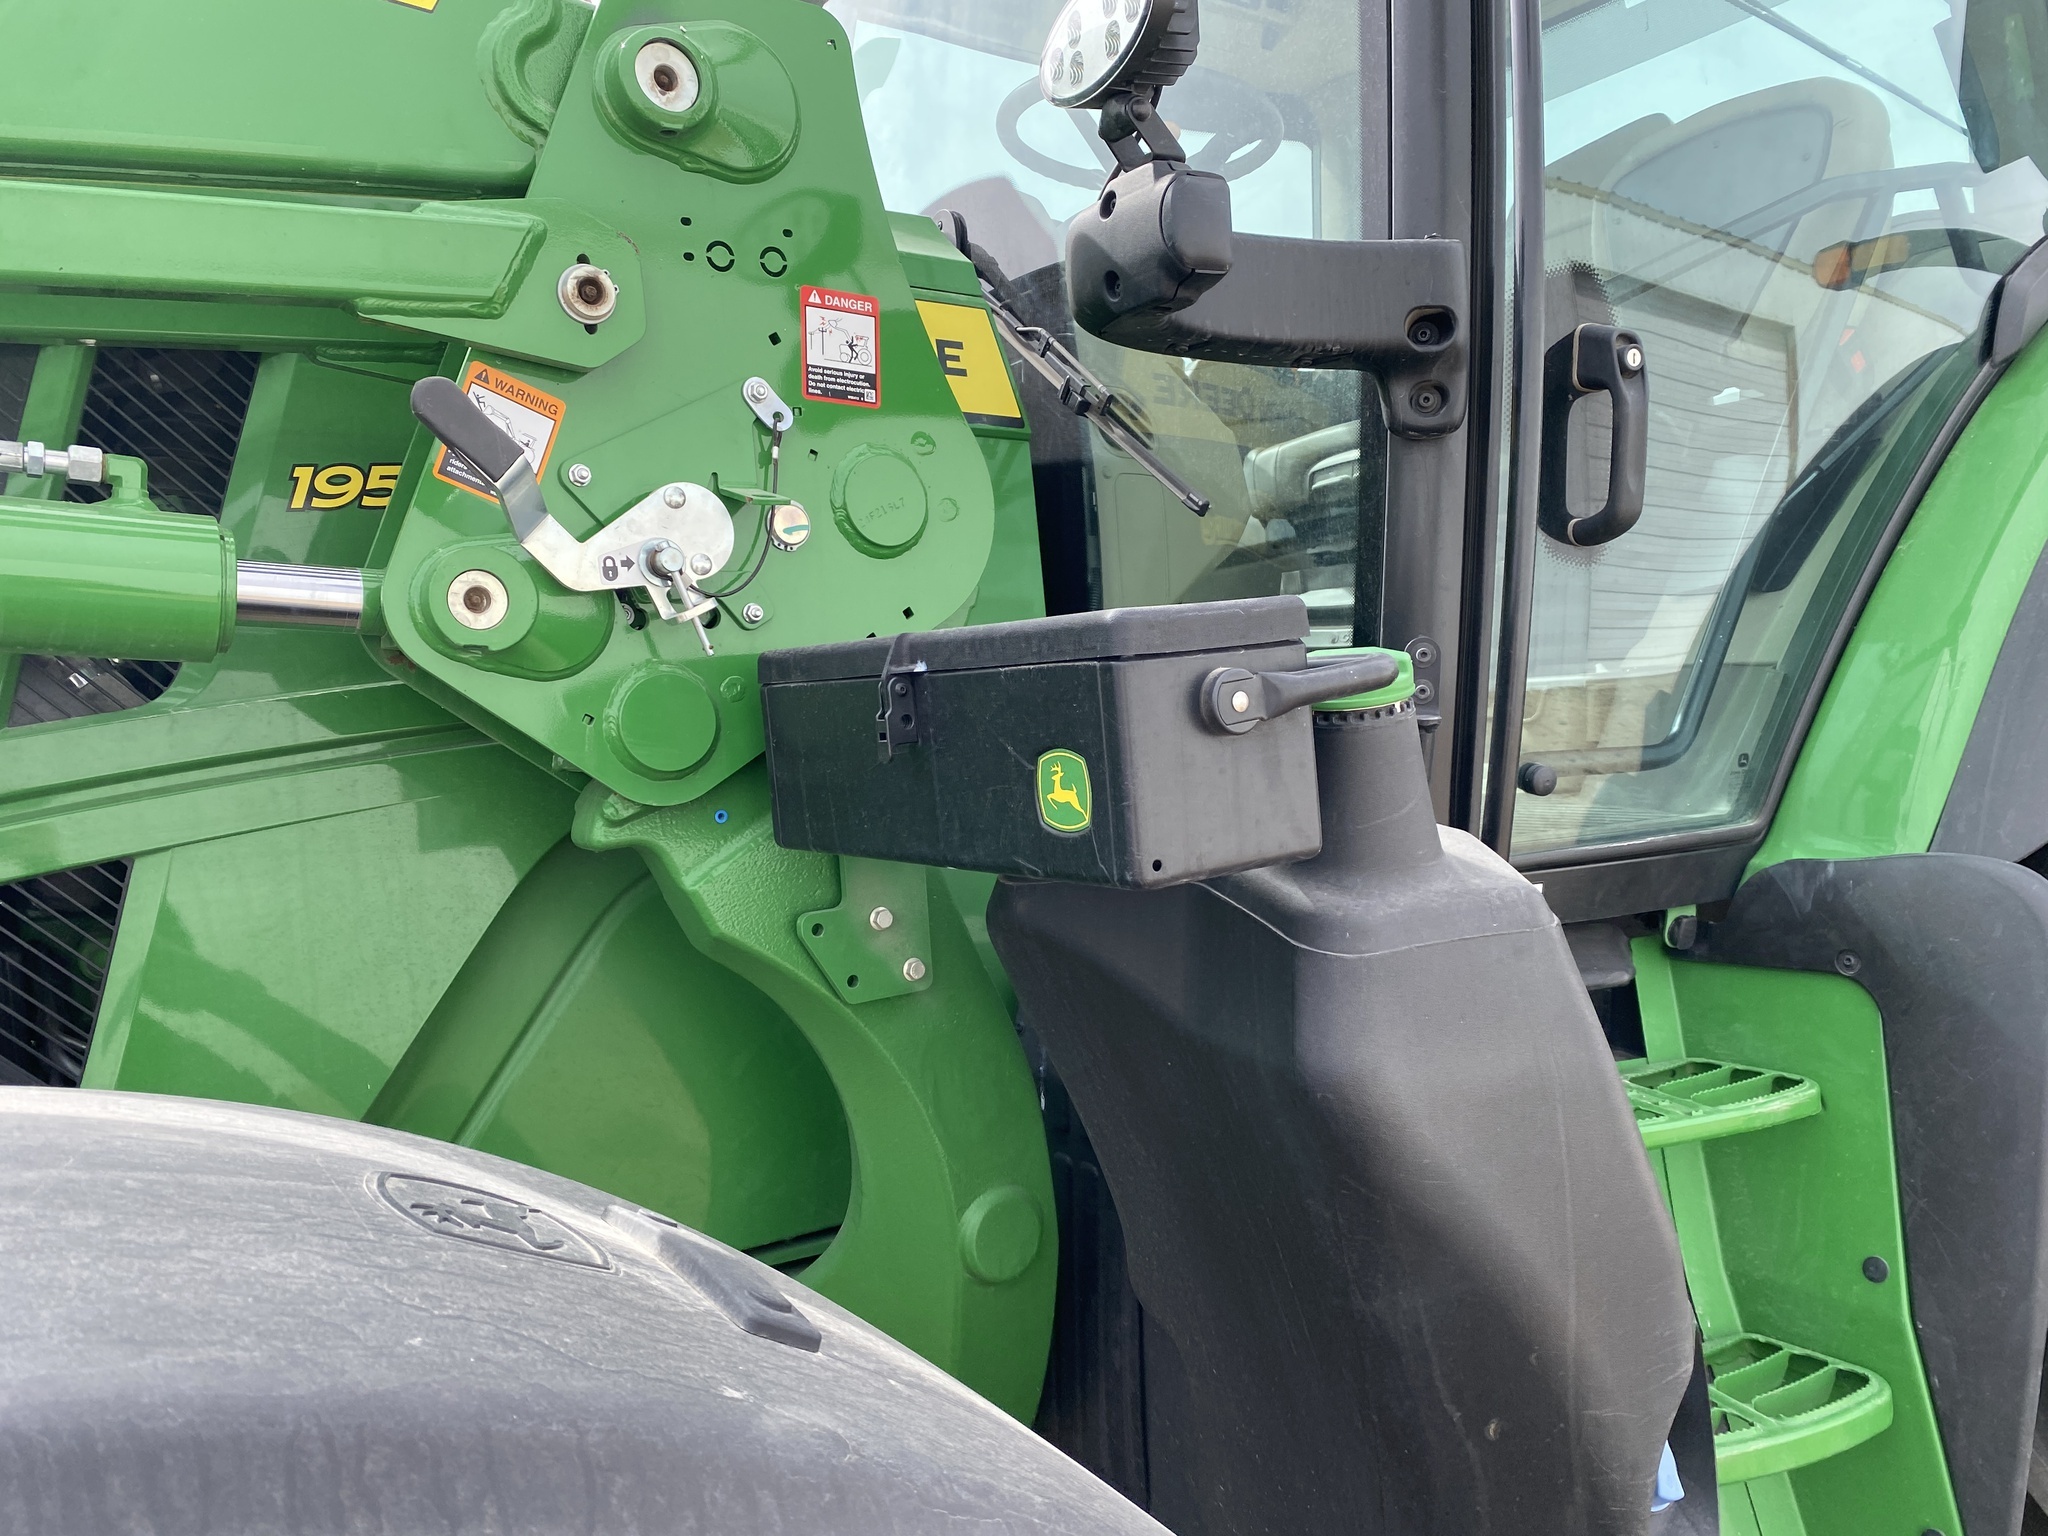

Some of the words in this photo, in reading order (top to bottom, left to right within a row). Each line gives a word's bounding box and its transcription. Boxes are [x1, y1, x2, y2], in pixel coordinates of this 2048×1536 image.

[824, 295, 873, 313] DANGER
[935, 339, 967, 377] E
[824, 368, 843, 376] serious
[844, 371, 858, 379] injury
[837, 378, 870, 387] electrocution.
[495, 377, 559, 416] WARNING
[288, 463, 403, 511] 195
